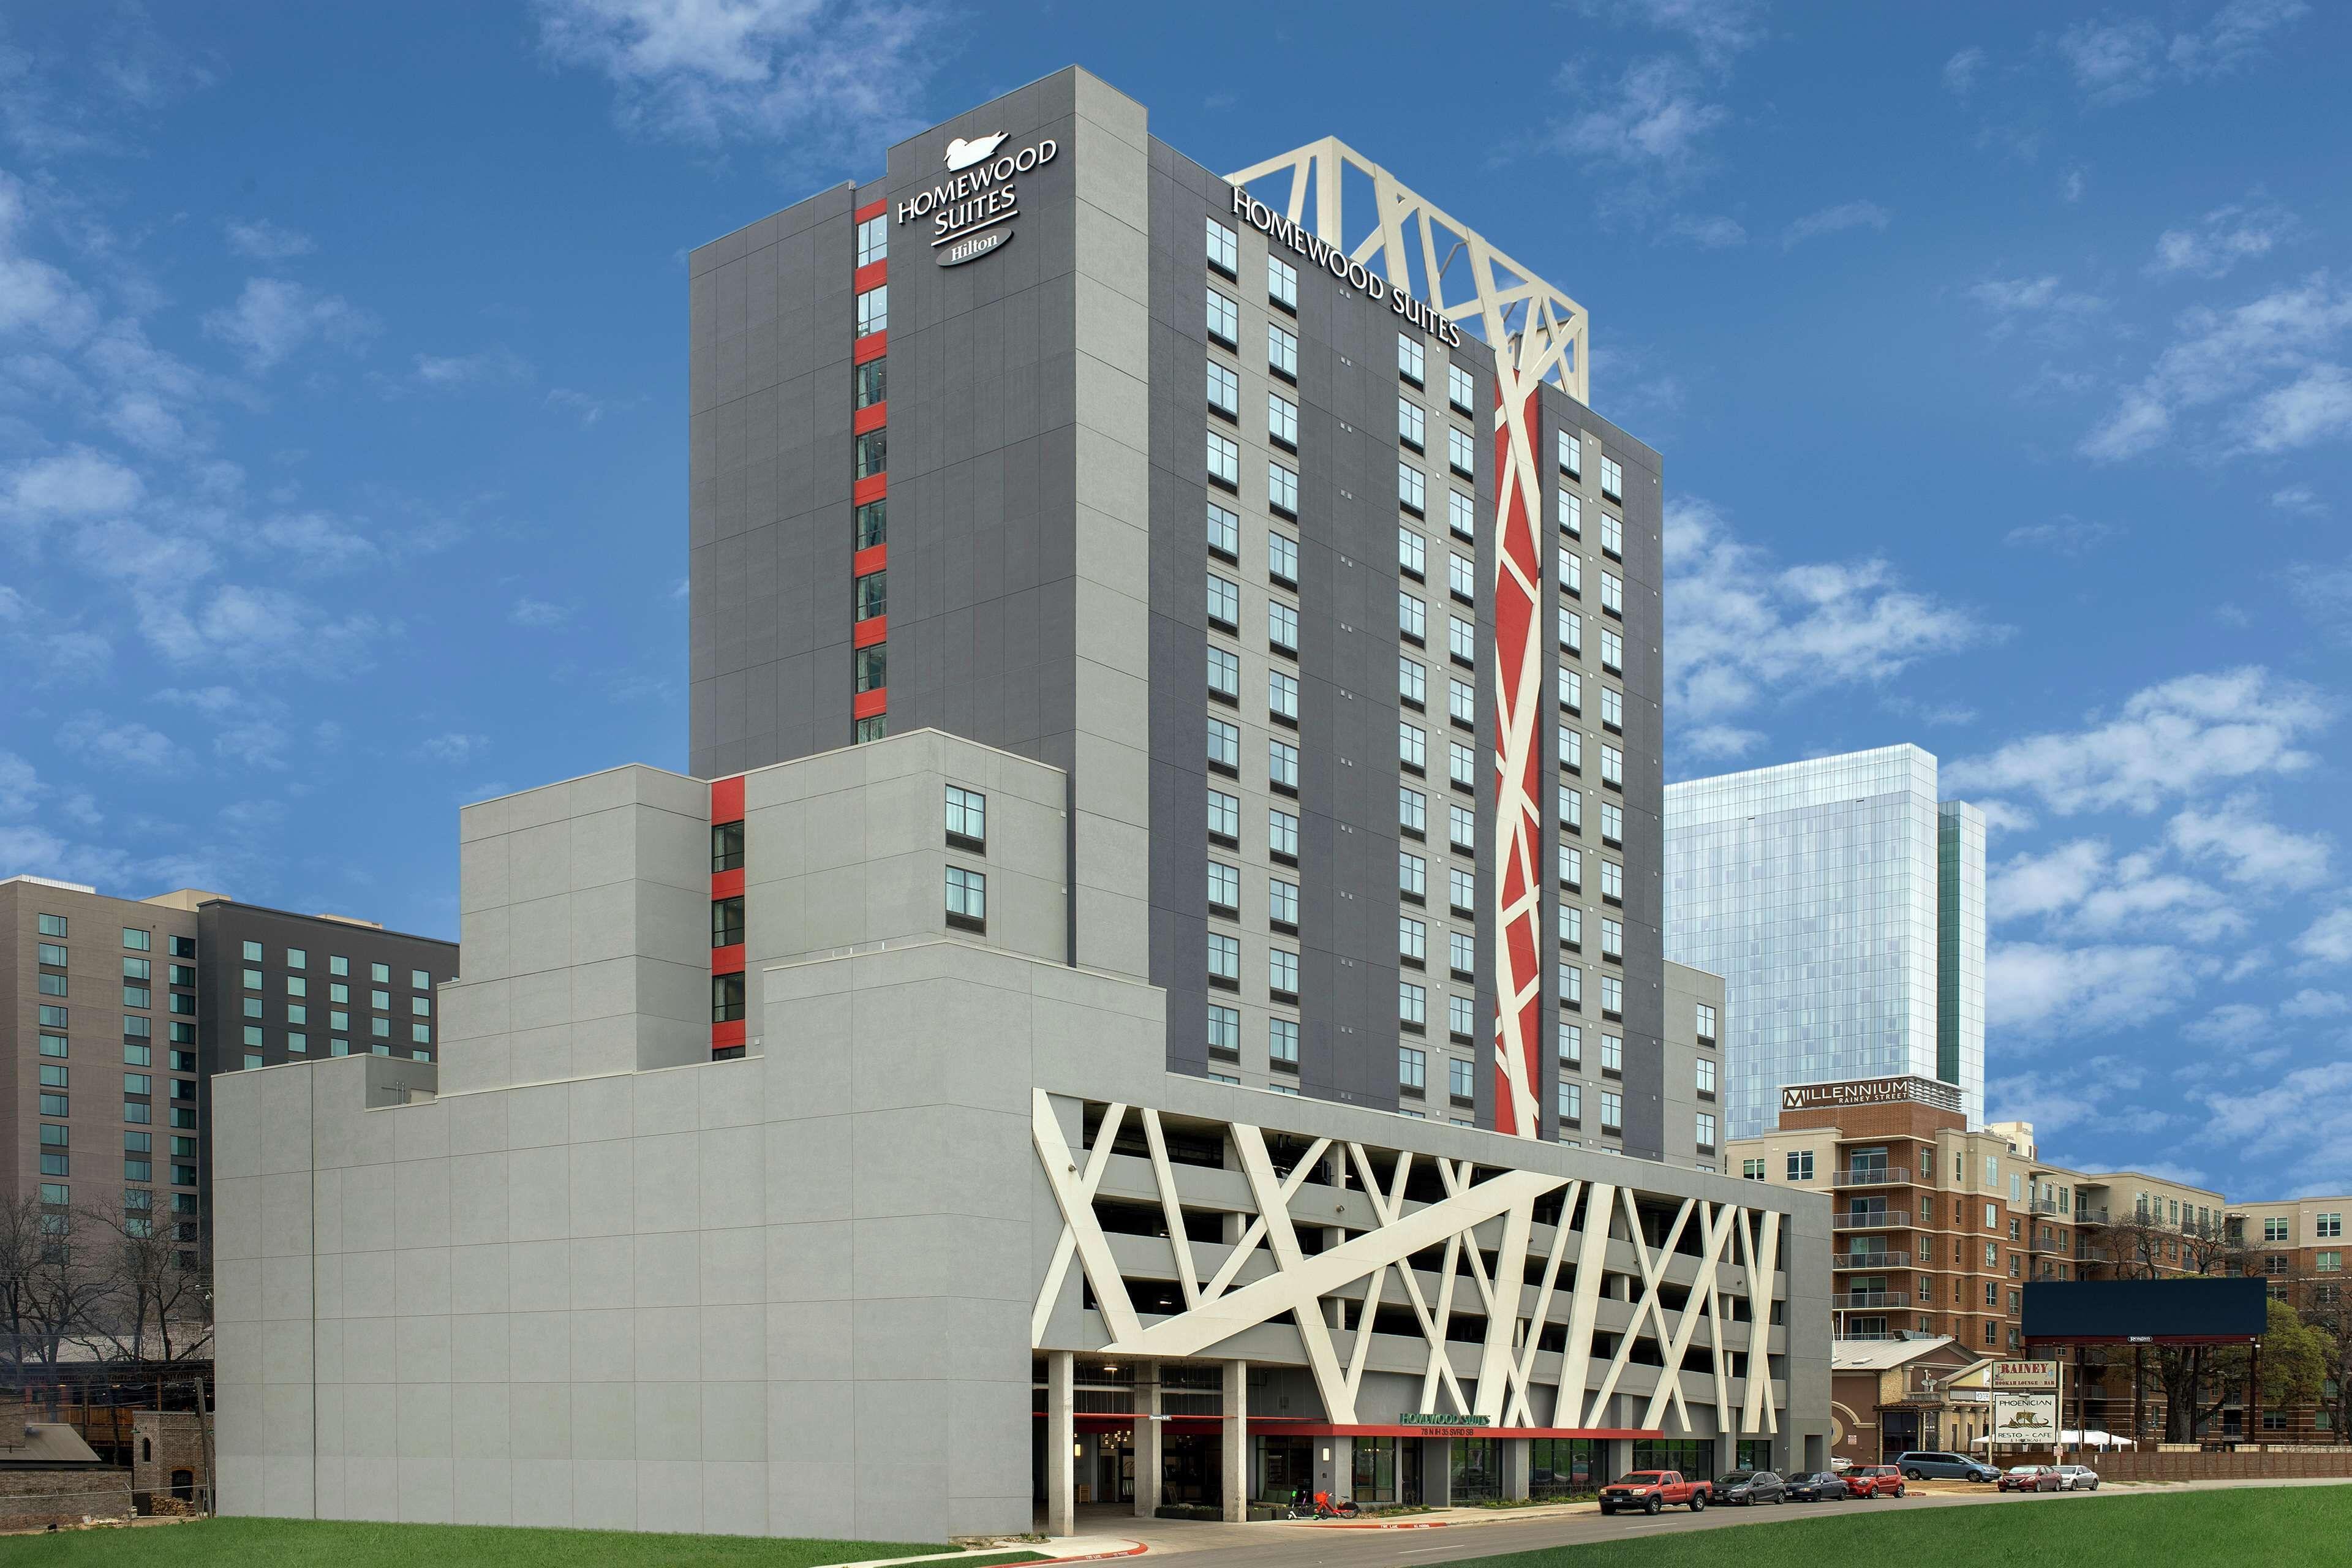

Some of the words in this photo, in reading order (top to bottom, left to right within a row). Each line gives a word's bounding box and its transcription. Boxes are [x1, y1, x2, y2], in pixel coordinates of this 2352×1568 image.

[897, 139, 1058, 225] HOMEWOOD
[934, 184, 1016, 236] SUITES
[951, 235, 998, 262] Hilton
[1232, 186, 1384, 300] HOMEWOOD
[1391, 287, 1460, 349] SUITES
[1783, 1079, 1908, 1107] MILLENNIUM
[1838, 1095, 1870, 1104] RAINEY
[1874, 1092, 1908, 1101] STREET
[2000, 1363, 2049, 1374] RAINEY
[1400, 1413, 1459, 1425] HOMEWOOD
